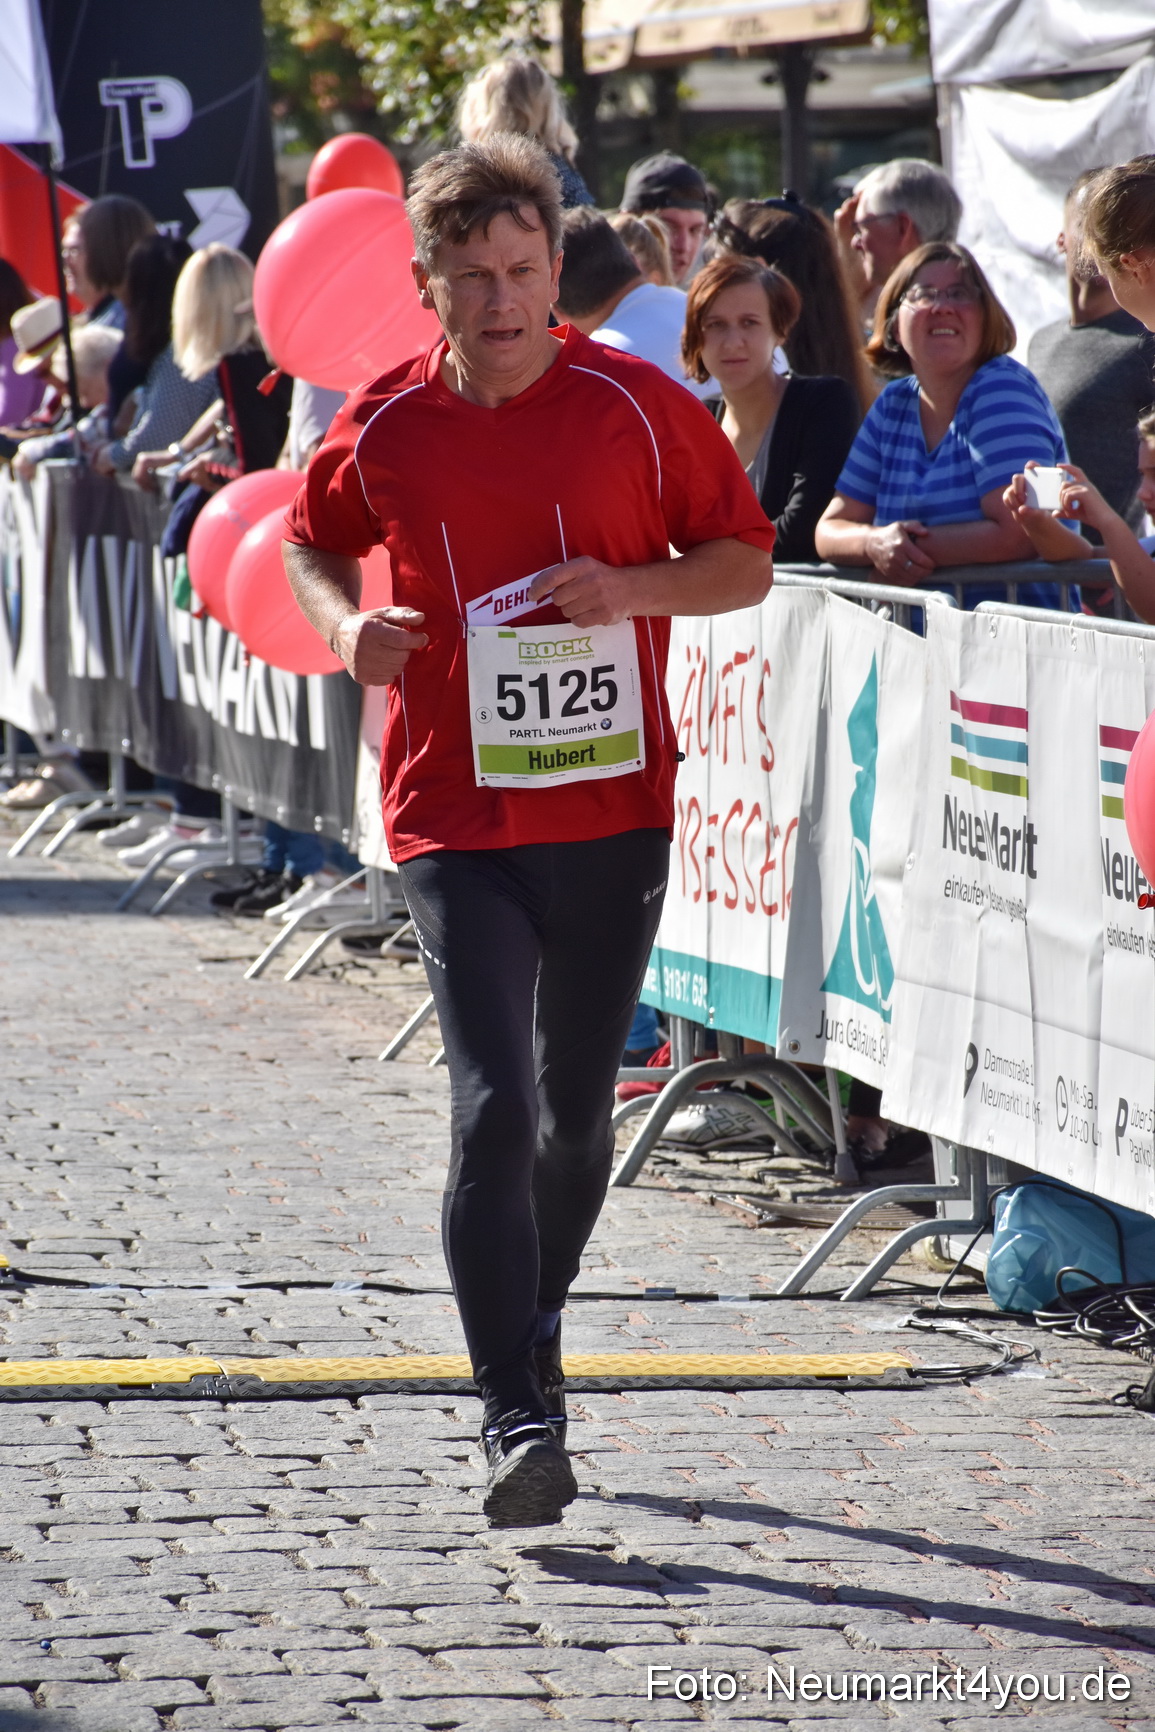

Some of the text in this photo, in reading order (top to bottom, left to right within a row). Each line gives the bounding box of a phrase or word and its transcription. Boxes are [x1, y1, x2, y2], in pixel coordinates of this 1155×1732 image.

[518, 636, 594, 658] BOCK
[543, 658, 551, 666] by
[570, 653, 595, 662] concepts
[496, 664, 618, 722] 5125
[480, 710, 487, 720] S
[509, 722, 597, 738] PARTL Neumarkt
[528, 744, 596, 770] Hubert
[1107, 921, 1145, 956] einkaufen
[815, 1009, 844, 1045] Jura
[980, 1081, 1020, 1116] Neumarkt
